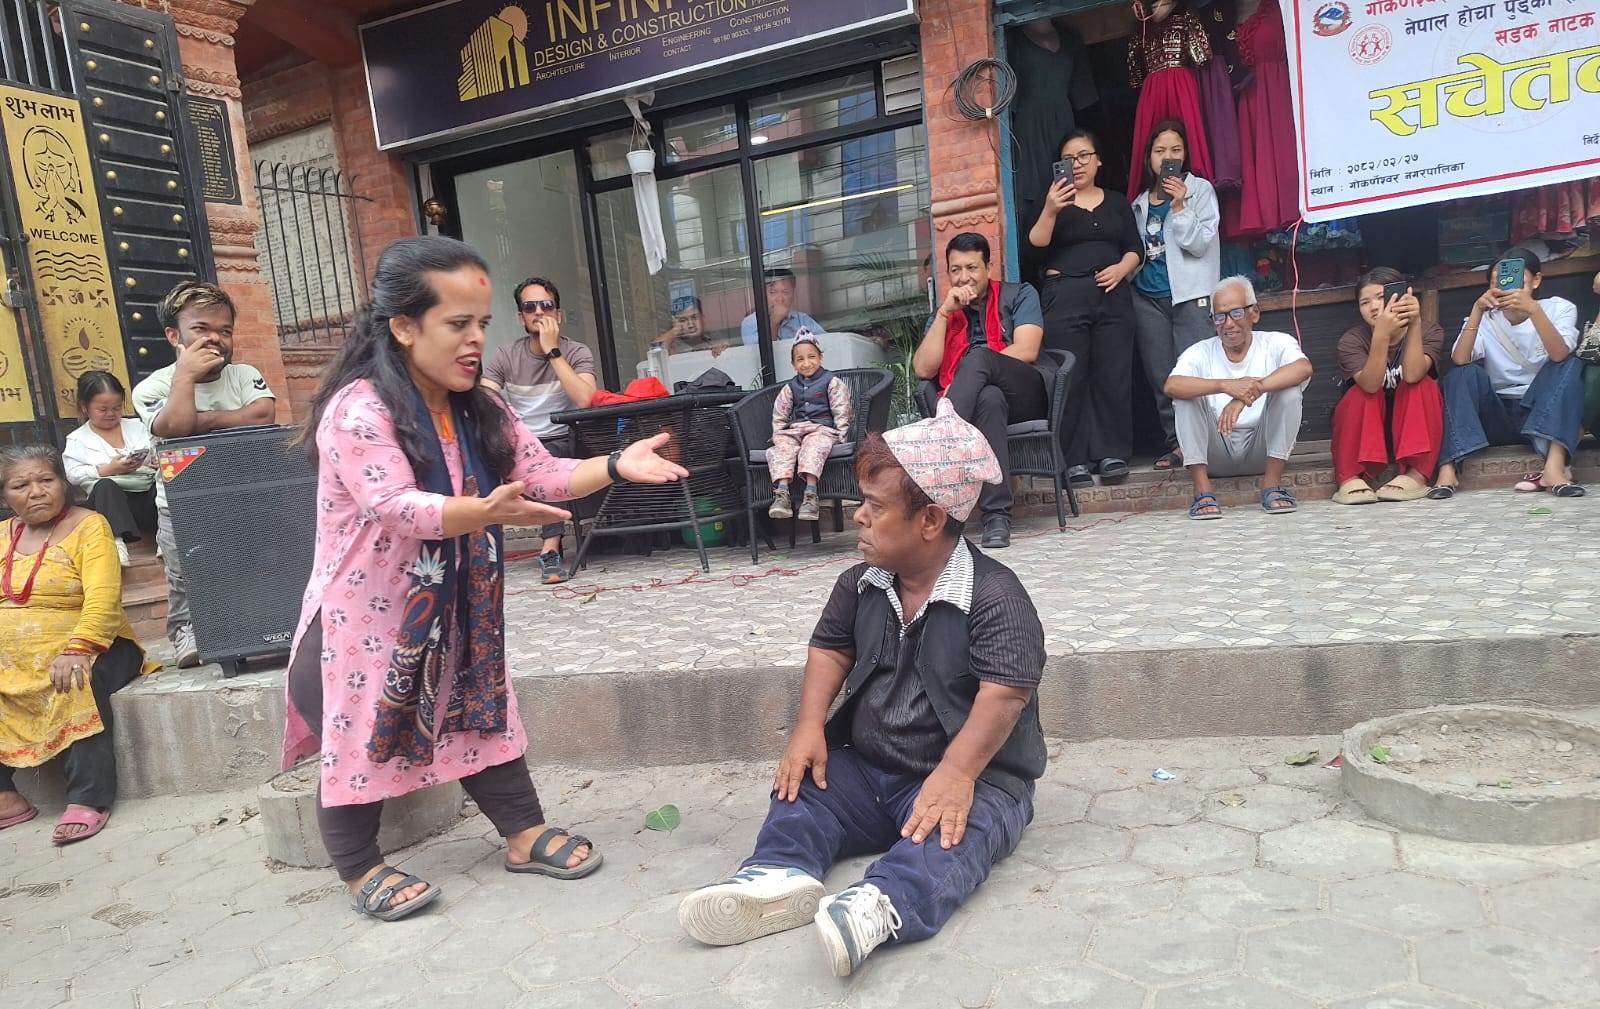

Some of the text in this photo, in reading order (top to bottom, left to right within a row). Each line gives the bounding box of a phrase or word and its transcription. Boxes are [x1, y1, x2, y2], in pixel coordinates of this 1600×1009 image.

[534, 0, 747, 67] DESIGN & CONSTRUCTION
[1405, 18, 1449, 36] नेपाल
[1457, 6, 1496, 27] होचा
[1495, 12, 1596, 46] सडक नाटक
[536, 5, 789, 80] ARCHITECTURE INTERIOR ENGINEERING CONSTRUCTION
[5, 96, 75, 123] शुभ लाभ
[1310, 168, 1331, 180] मिति
[1347, 153, 1419, 174] २०८२/०२/२७
[1310, 185, 1334, 196] स्थान
[1404, 161, 1465, 180] नगरपालिका
[30, 228, 99, 244] WELCOME
